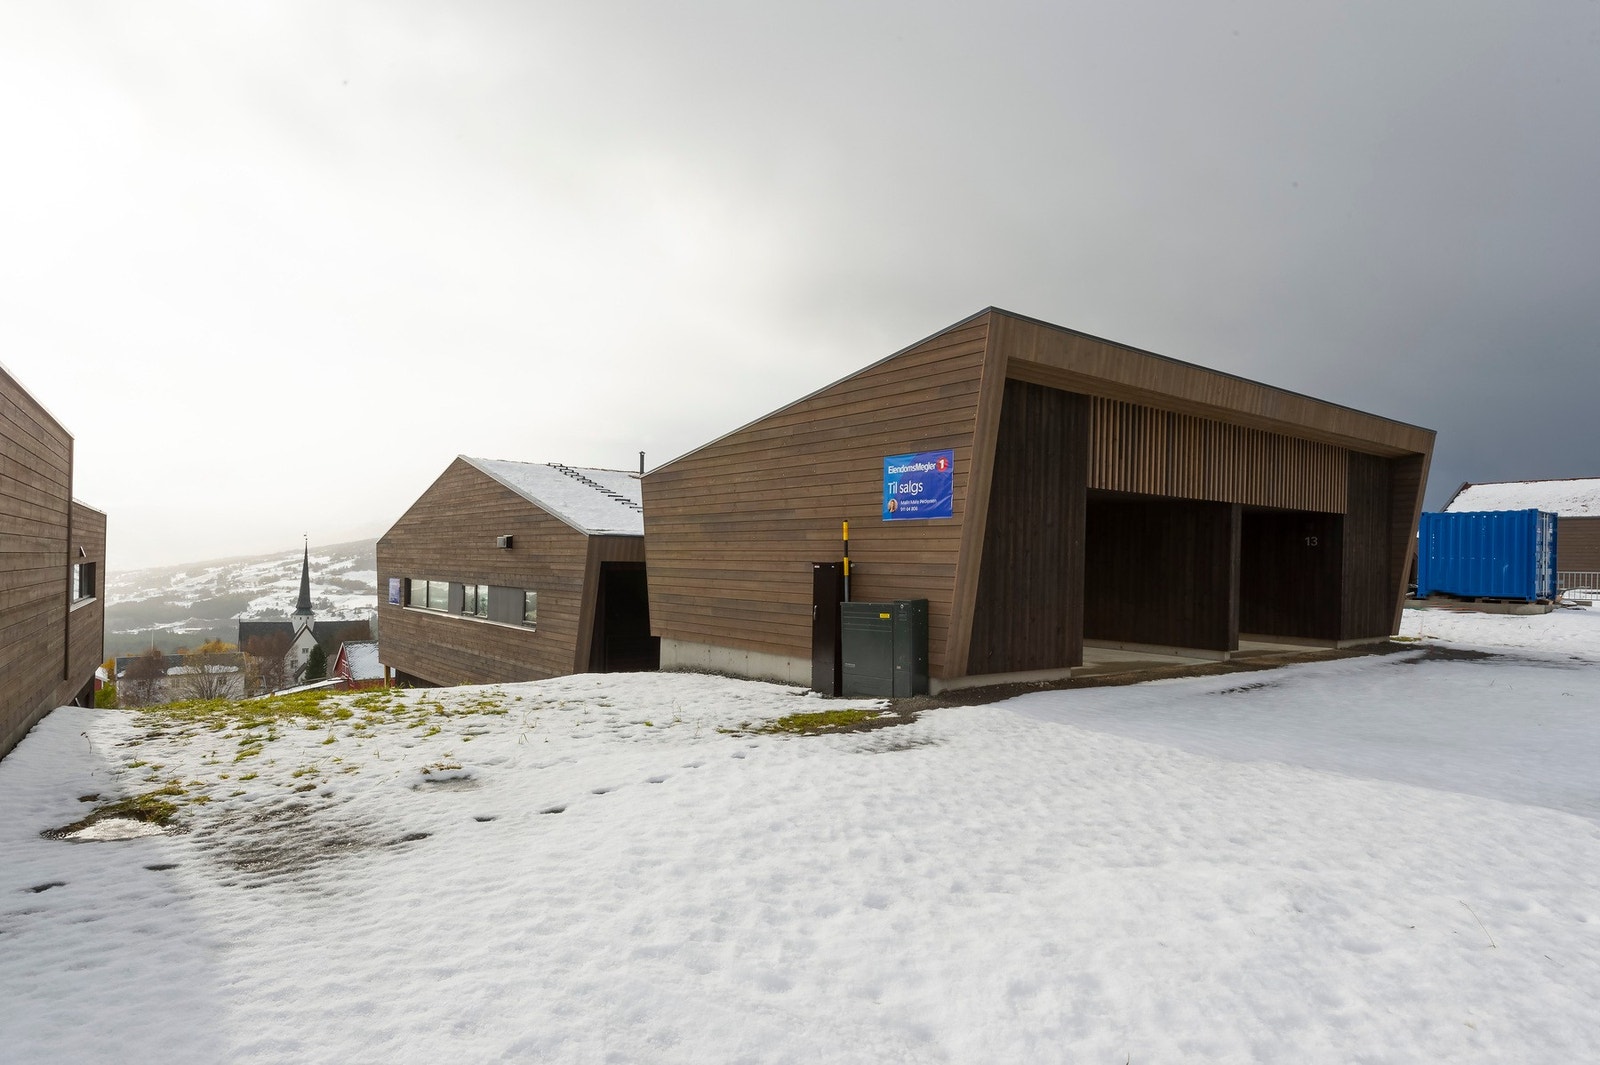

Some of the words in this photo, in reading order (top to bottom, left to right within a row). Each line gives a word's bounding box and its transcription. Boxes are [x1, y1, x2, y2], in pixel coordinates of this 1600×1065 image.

[888, 481, 897, 494] Til
[899, 480, 923, 495] salgs
[1304, 536, 1318, 546] 13
